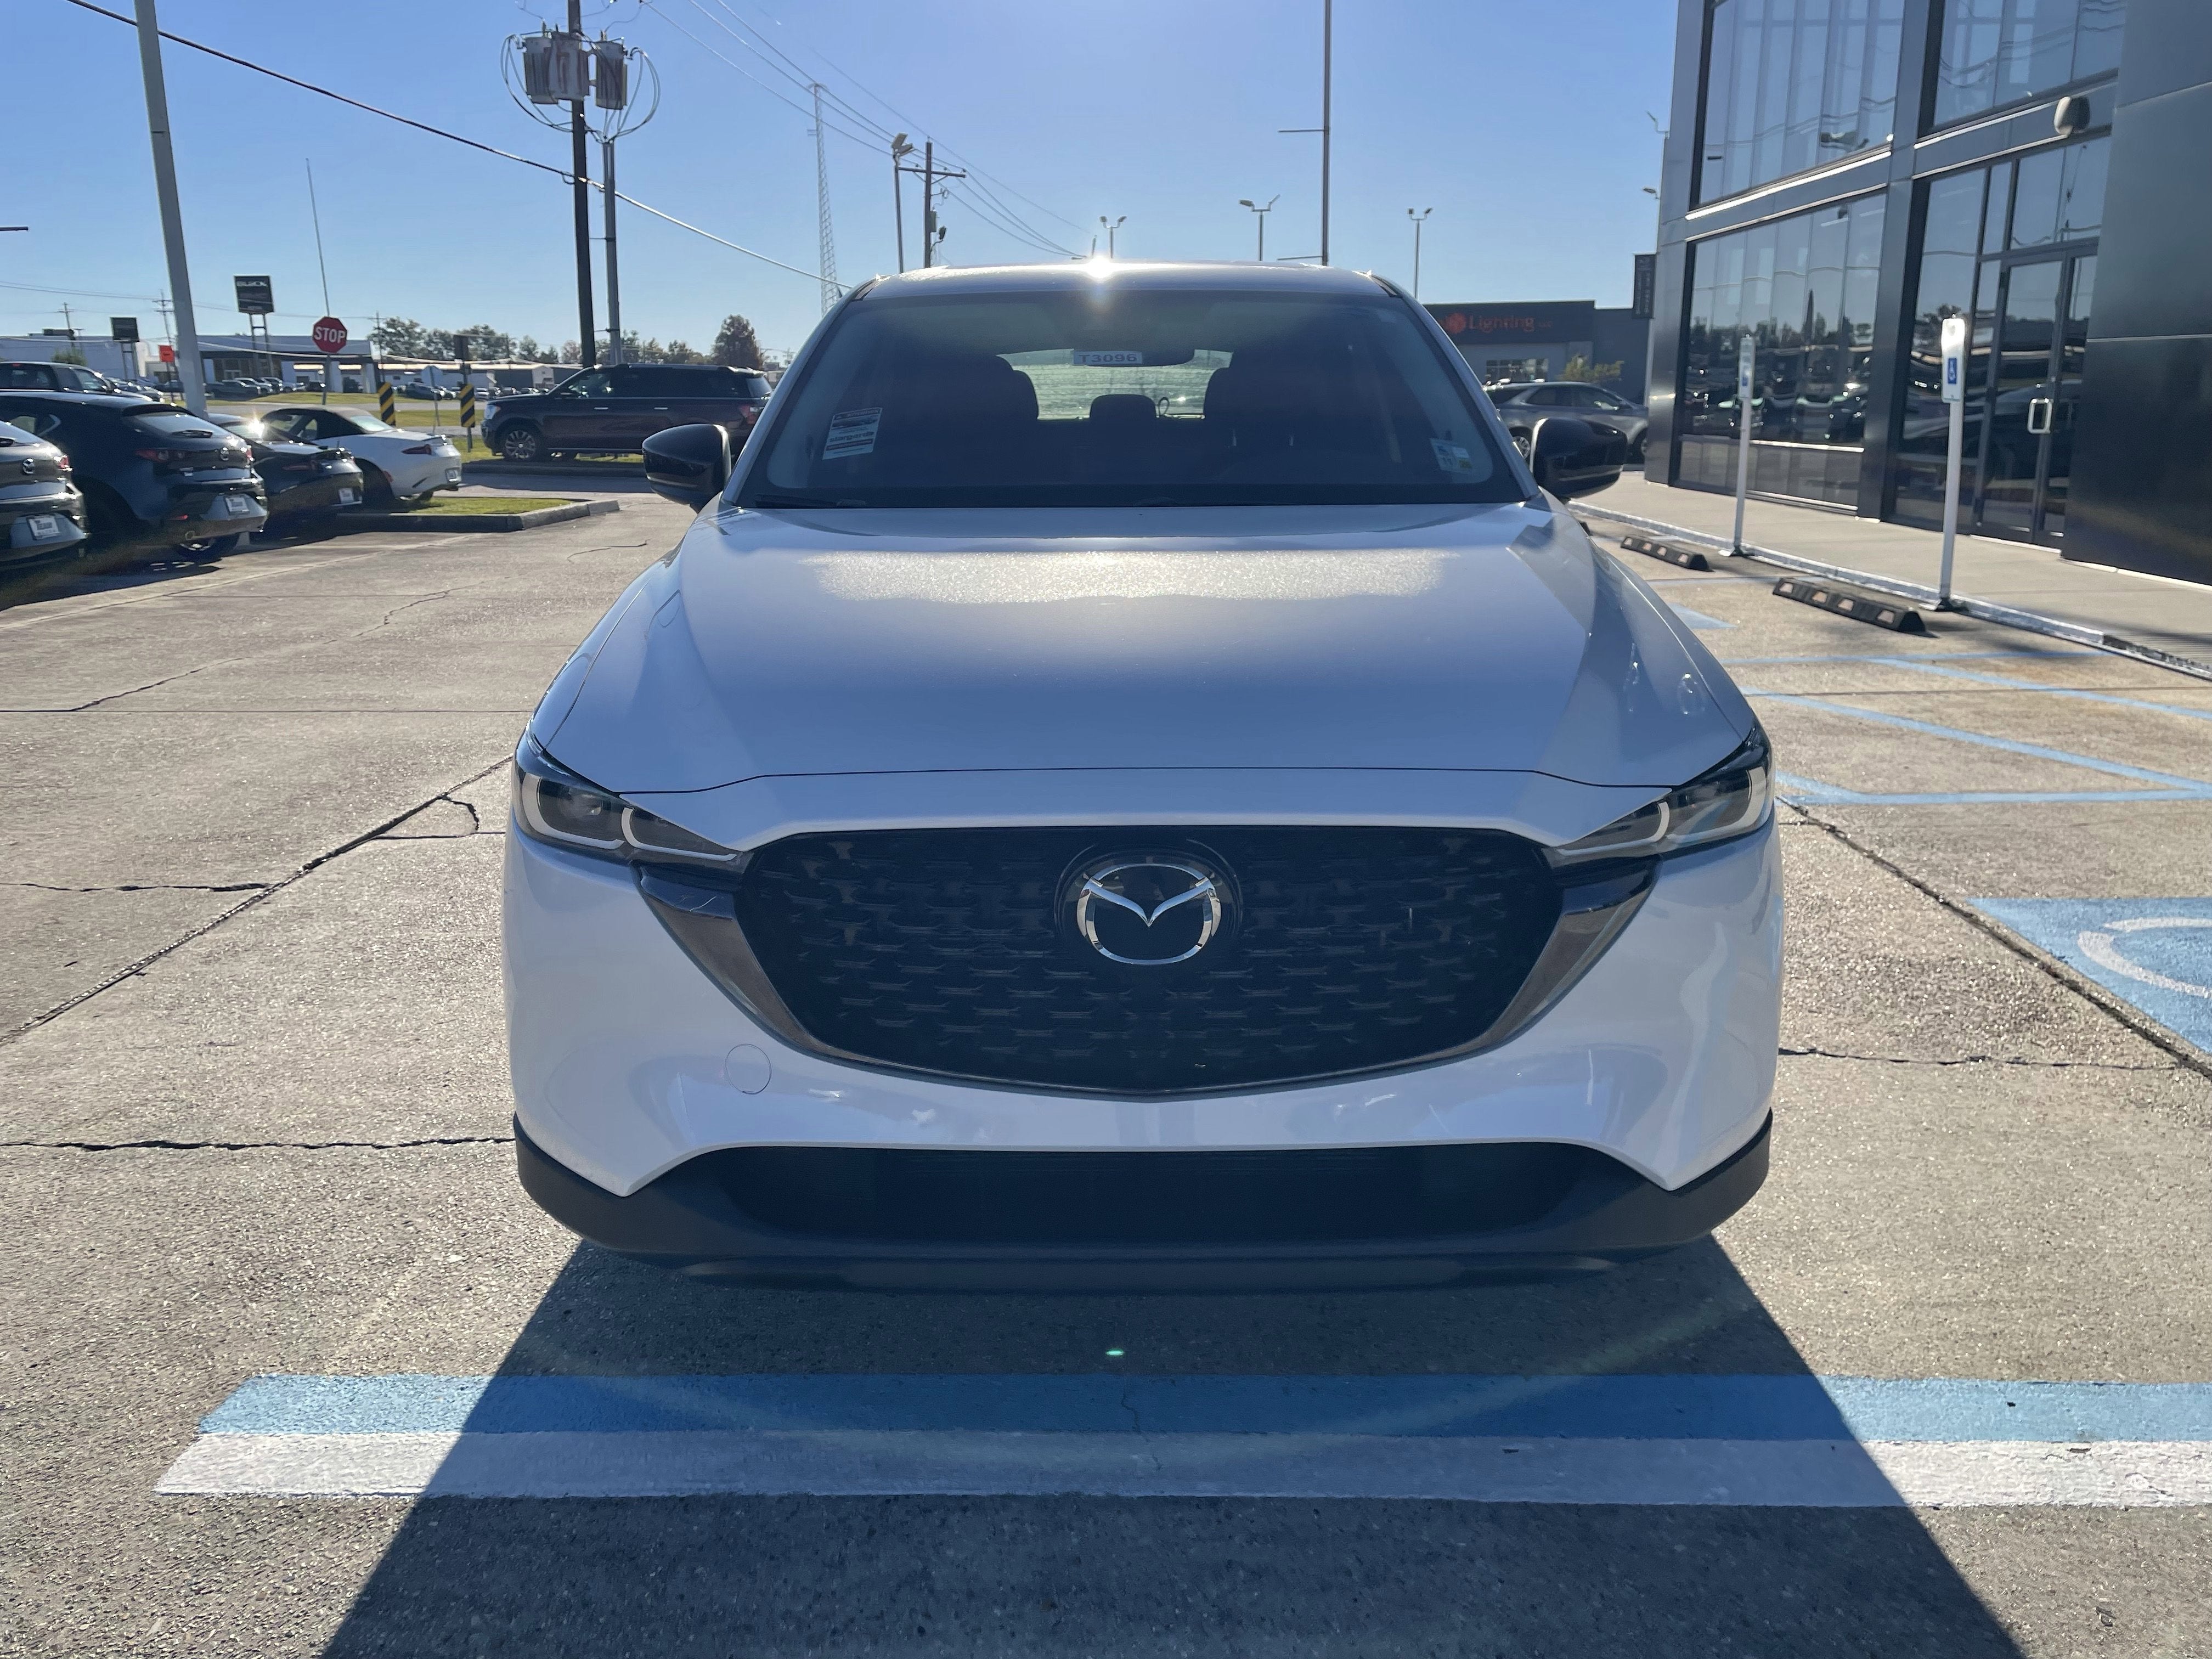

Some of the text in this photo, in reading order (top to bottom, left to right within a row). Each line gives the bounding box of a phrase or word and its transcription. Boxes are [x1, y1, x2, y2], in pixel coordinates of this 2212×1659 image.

[1469, 315, 1535, 333] Lighting
[314, 326, 346, 344] STOP
[1078, 353, 1137, 363] T3096
